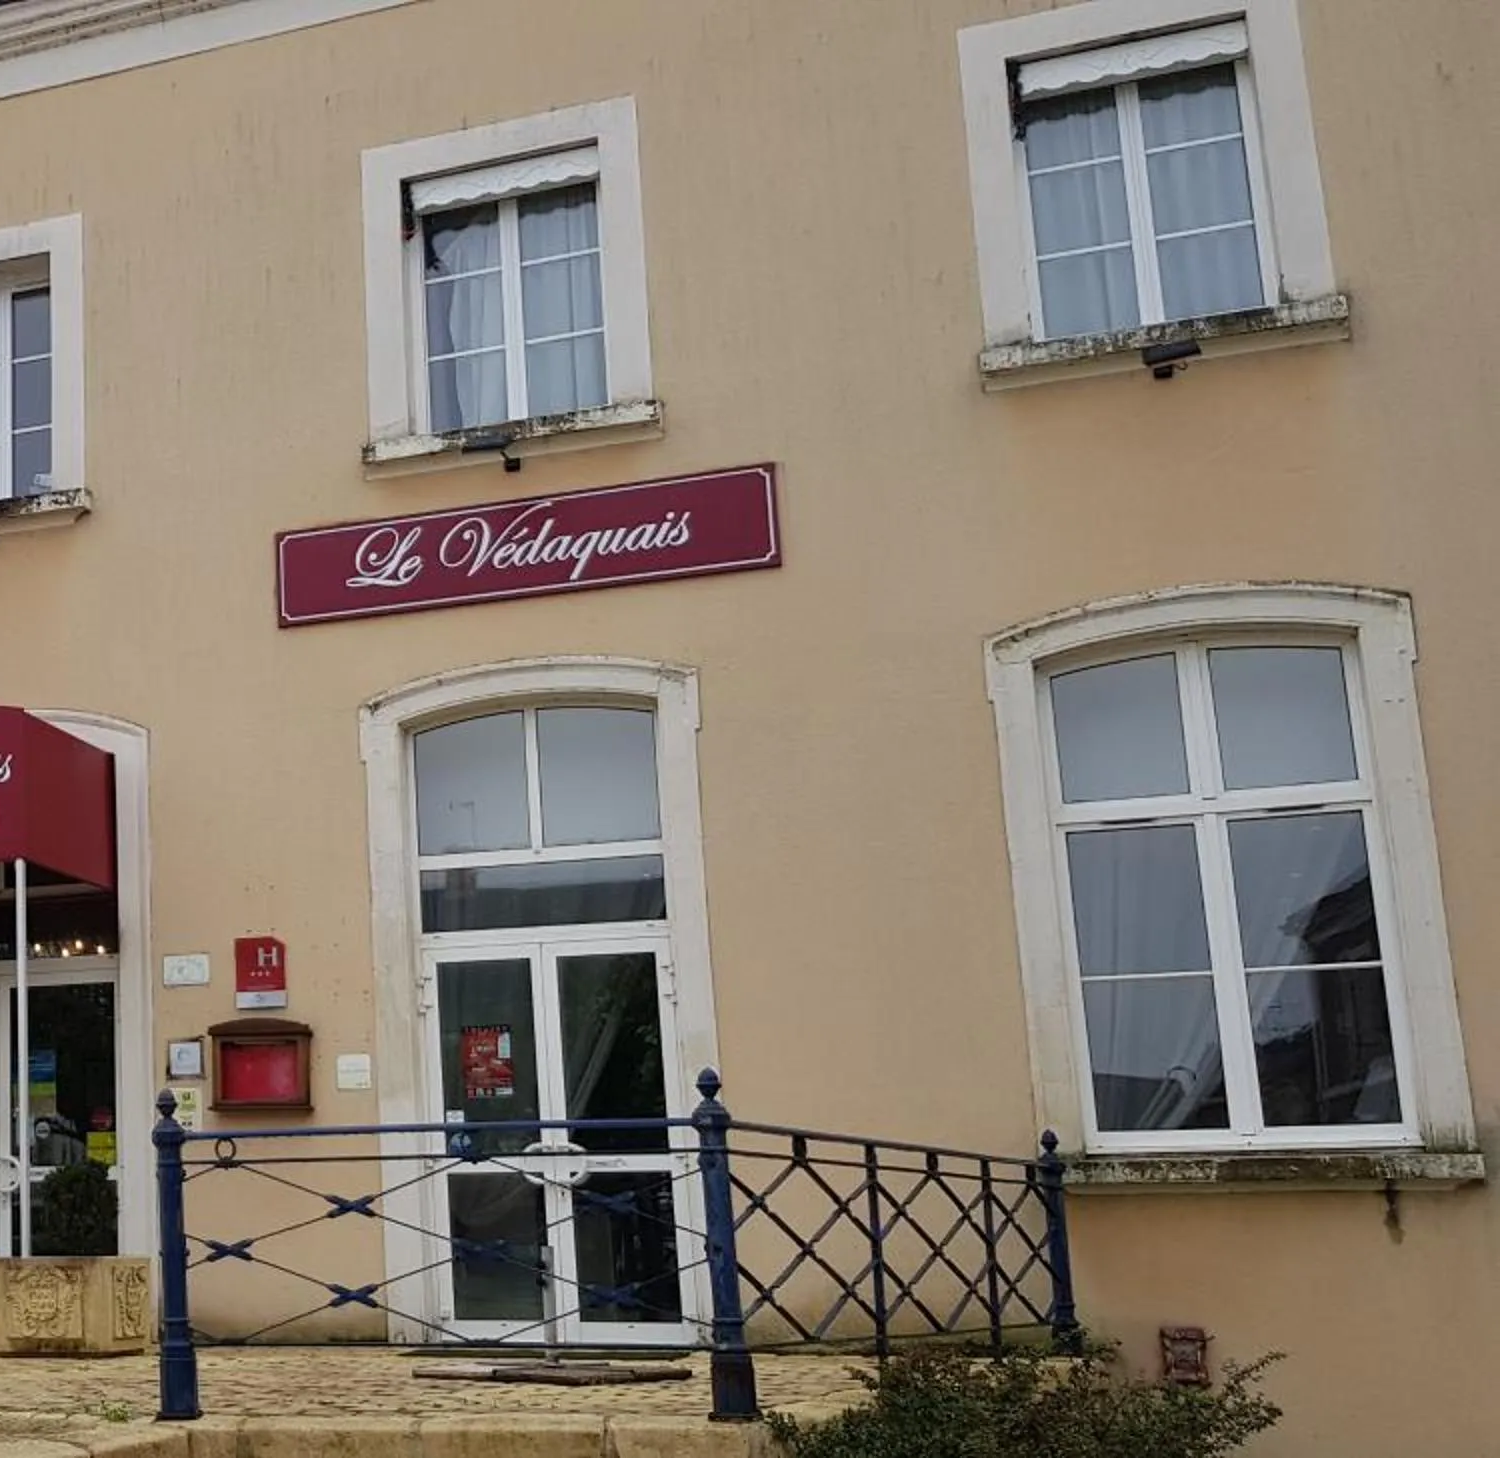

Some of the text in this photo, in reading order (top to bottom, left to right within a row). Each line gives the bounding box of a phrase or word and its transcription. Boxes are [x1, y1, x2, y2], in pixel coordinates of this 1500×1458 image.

[346, 501, 692, 587] Le Védaquais
[256, 946, 278, 968] H
